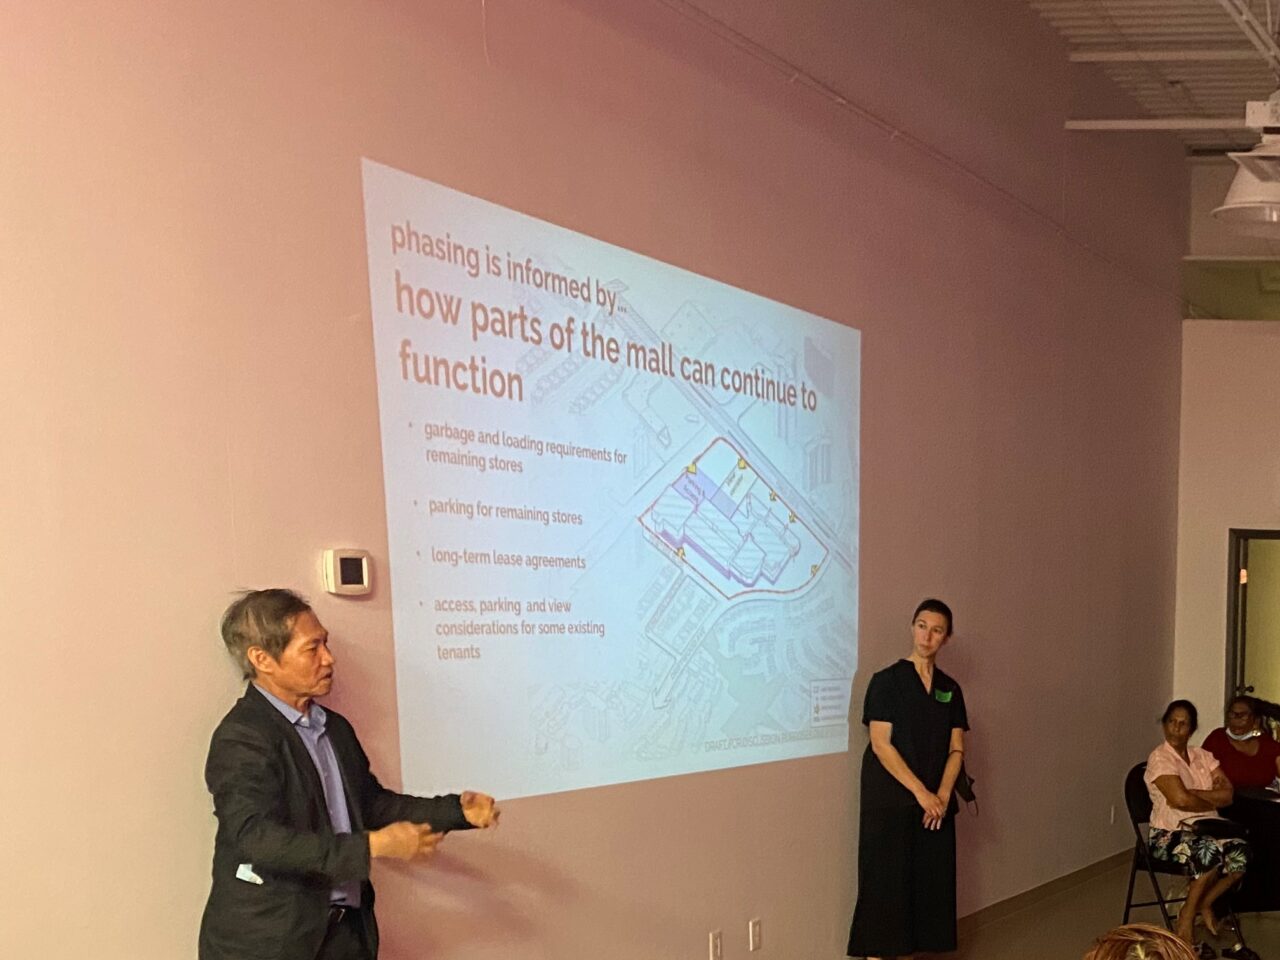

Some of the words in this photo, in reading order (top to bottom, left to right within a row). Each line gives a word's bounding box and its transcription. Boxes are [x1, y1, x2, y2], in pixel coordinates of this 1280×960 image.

[391, 220, 480, 277] phasing
[486, 245, 501, 277] is
[507, 252, 591, 303] informed
[596, 279, 627, 316] by...
[395, 269, 462, 326] how
[471, 301, 543, 346] parts
[550, 317, 575, 352] of
[581, 321, 619, 364] the
[626, 341, 675, 377] mall
[680, 356, 715, 387] can
[720, 366, 797, 407] continue
[801, 382, 817, 411] to
[399, 338, 523, 402] function
[424, 422, 475, 445] garbage
[478, 430, 499, 446] and
[502, 431, 544, 456] loading
[546, 442, 612, 462] requirements
[614, 449, 628, 465] for
[426, 448, 486, 472] remaining
[488, 456, 523, 473] stores
[429, 499, 473, 519] parking
[476, 501, 493, 517] for
[495, 505, 549, 525] remaining
[551, 511, 583, 525] stores
[431, 546, 491, 566] long-term
[493, 550, 523, 566] lease
[525, 554, 586, 570] agreements
[434, 598, 477, 613] access,
[480, 597, 521, 615] parking
[526, 598, 546, 613] and
[548, 599, 571, 613] view
[435, 620, 518, 636] considerations
[521, 620, 535, 635] for
[538, 623, 565, 634] some
[567, 621, 605, 637] existing
[437, 645, 481, 660] tenants
